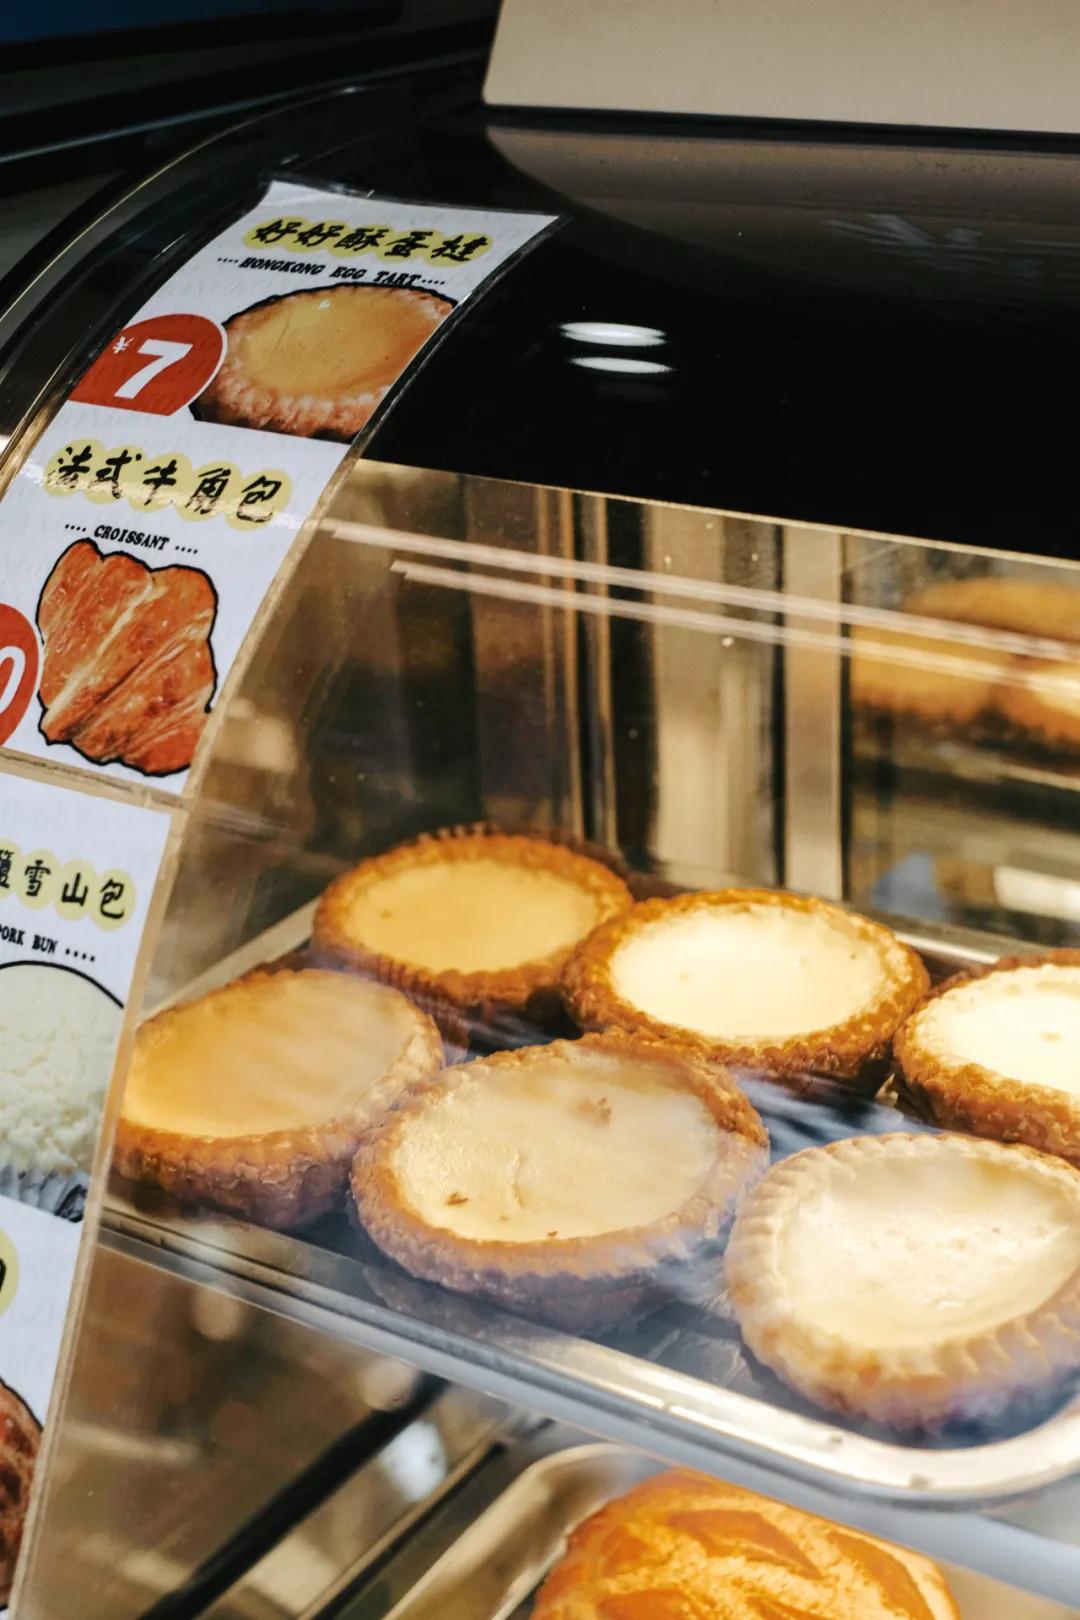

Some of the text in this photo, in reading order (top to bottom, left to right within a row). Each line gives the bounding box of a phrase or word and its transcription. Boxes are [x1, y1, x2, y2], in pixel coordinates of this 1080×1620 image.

[239, 256, 423, 285] HONGKONG EGG TART
[48, 445, 282, 523] 法式牛角包
[94, 524, 170, 550] CROISSANT
[0, 924, 58, 955] ORK BUN
